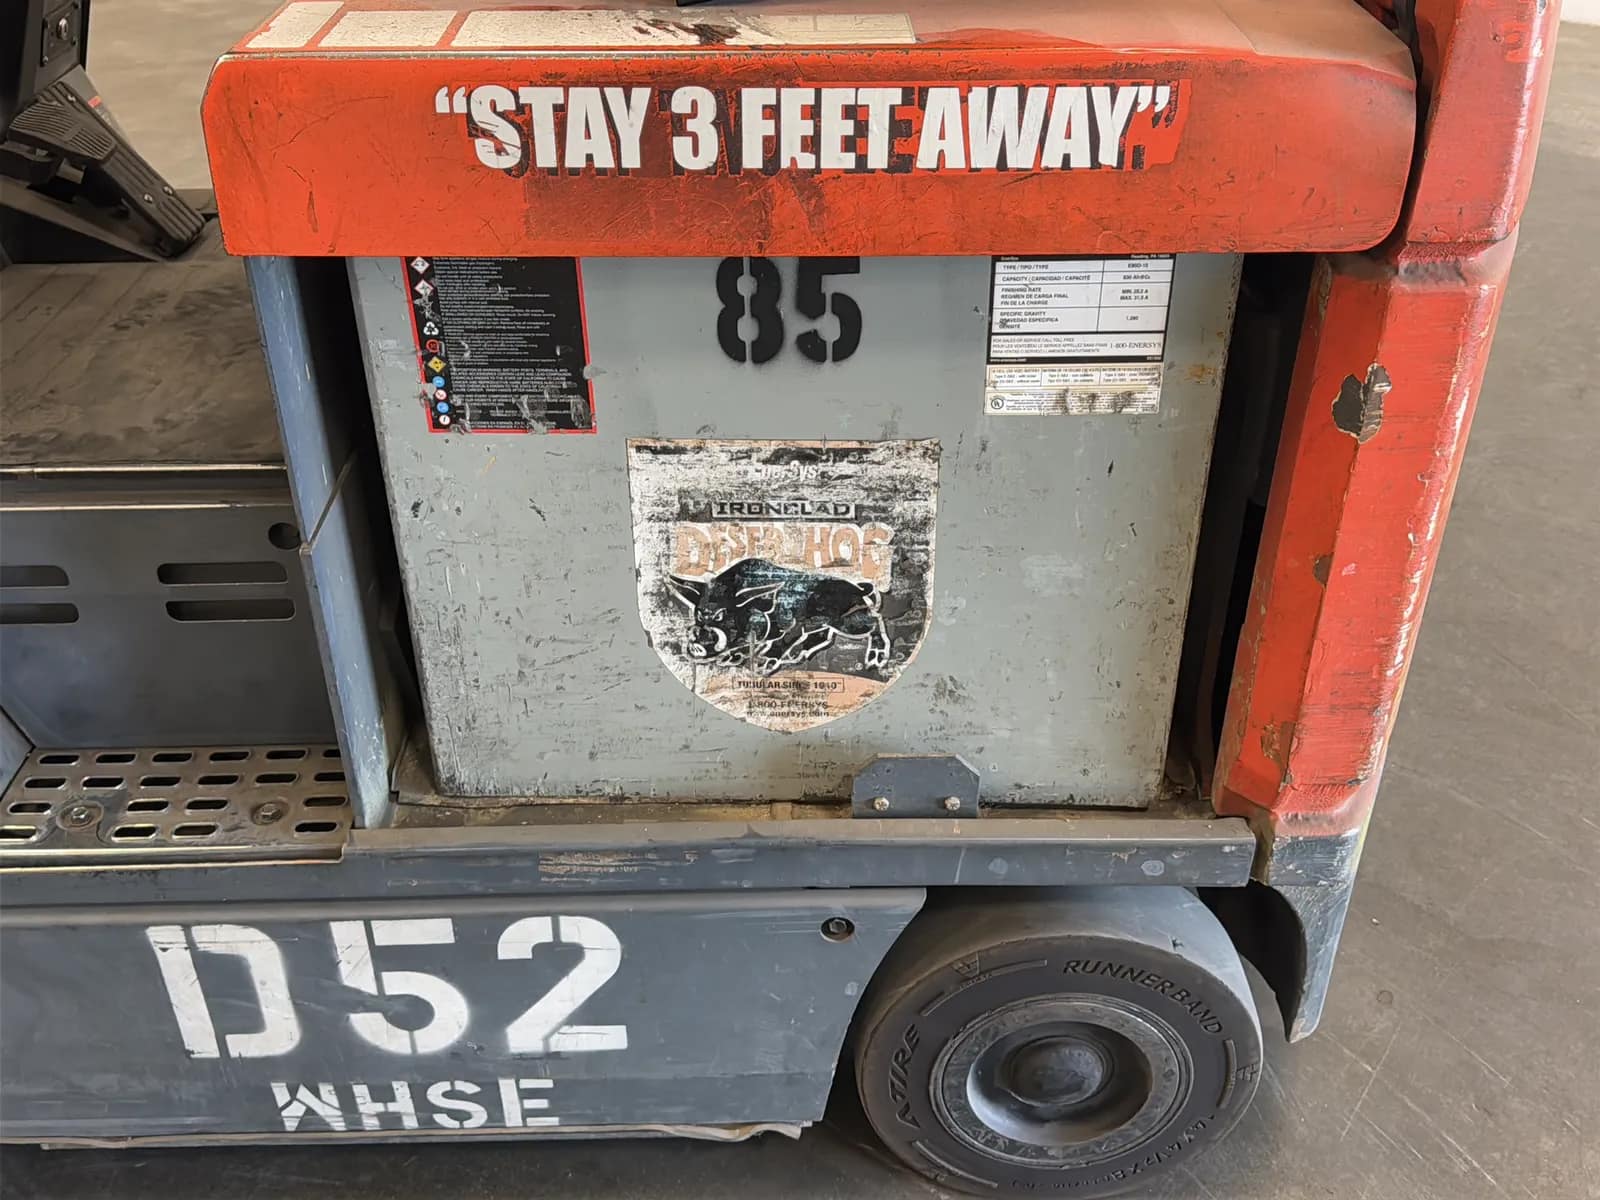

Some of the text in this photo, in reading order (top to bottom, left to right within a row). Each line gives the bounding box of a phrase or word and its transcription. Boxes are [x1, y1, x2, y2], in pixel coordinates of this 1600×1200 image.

[671, 86, 719, 170] 3
[741, 86, 902, 170] FEET
[716, 256, 862, 363] 85
[715, 502, 851, 516] IRONCLAD
[805, 525, 892, 588] HOG
[145, 914, 629, 1059] D52
[1063, 960, 1224, 1034] RUNNERBAND
[270, 1077, 560, 1131] WHSE
